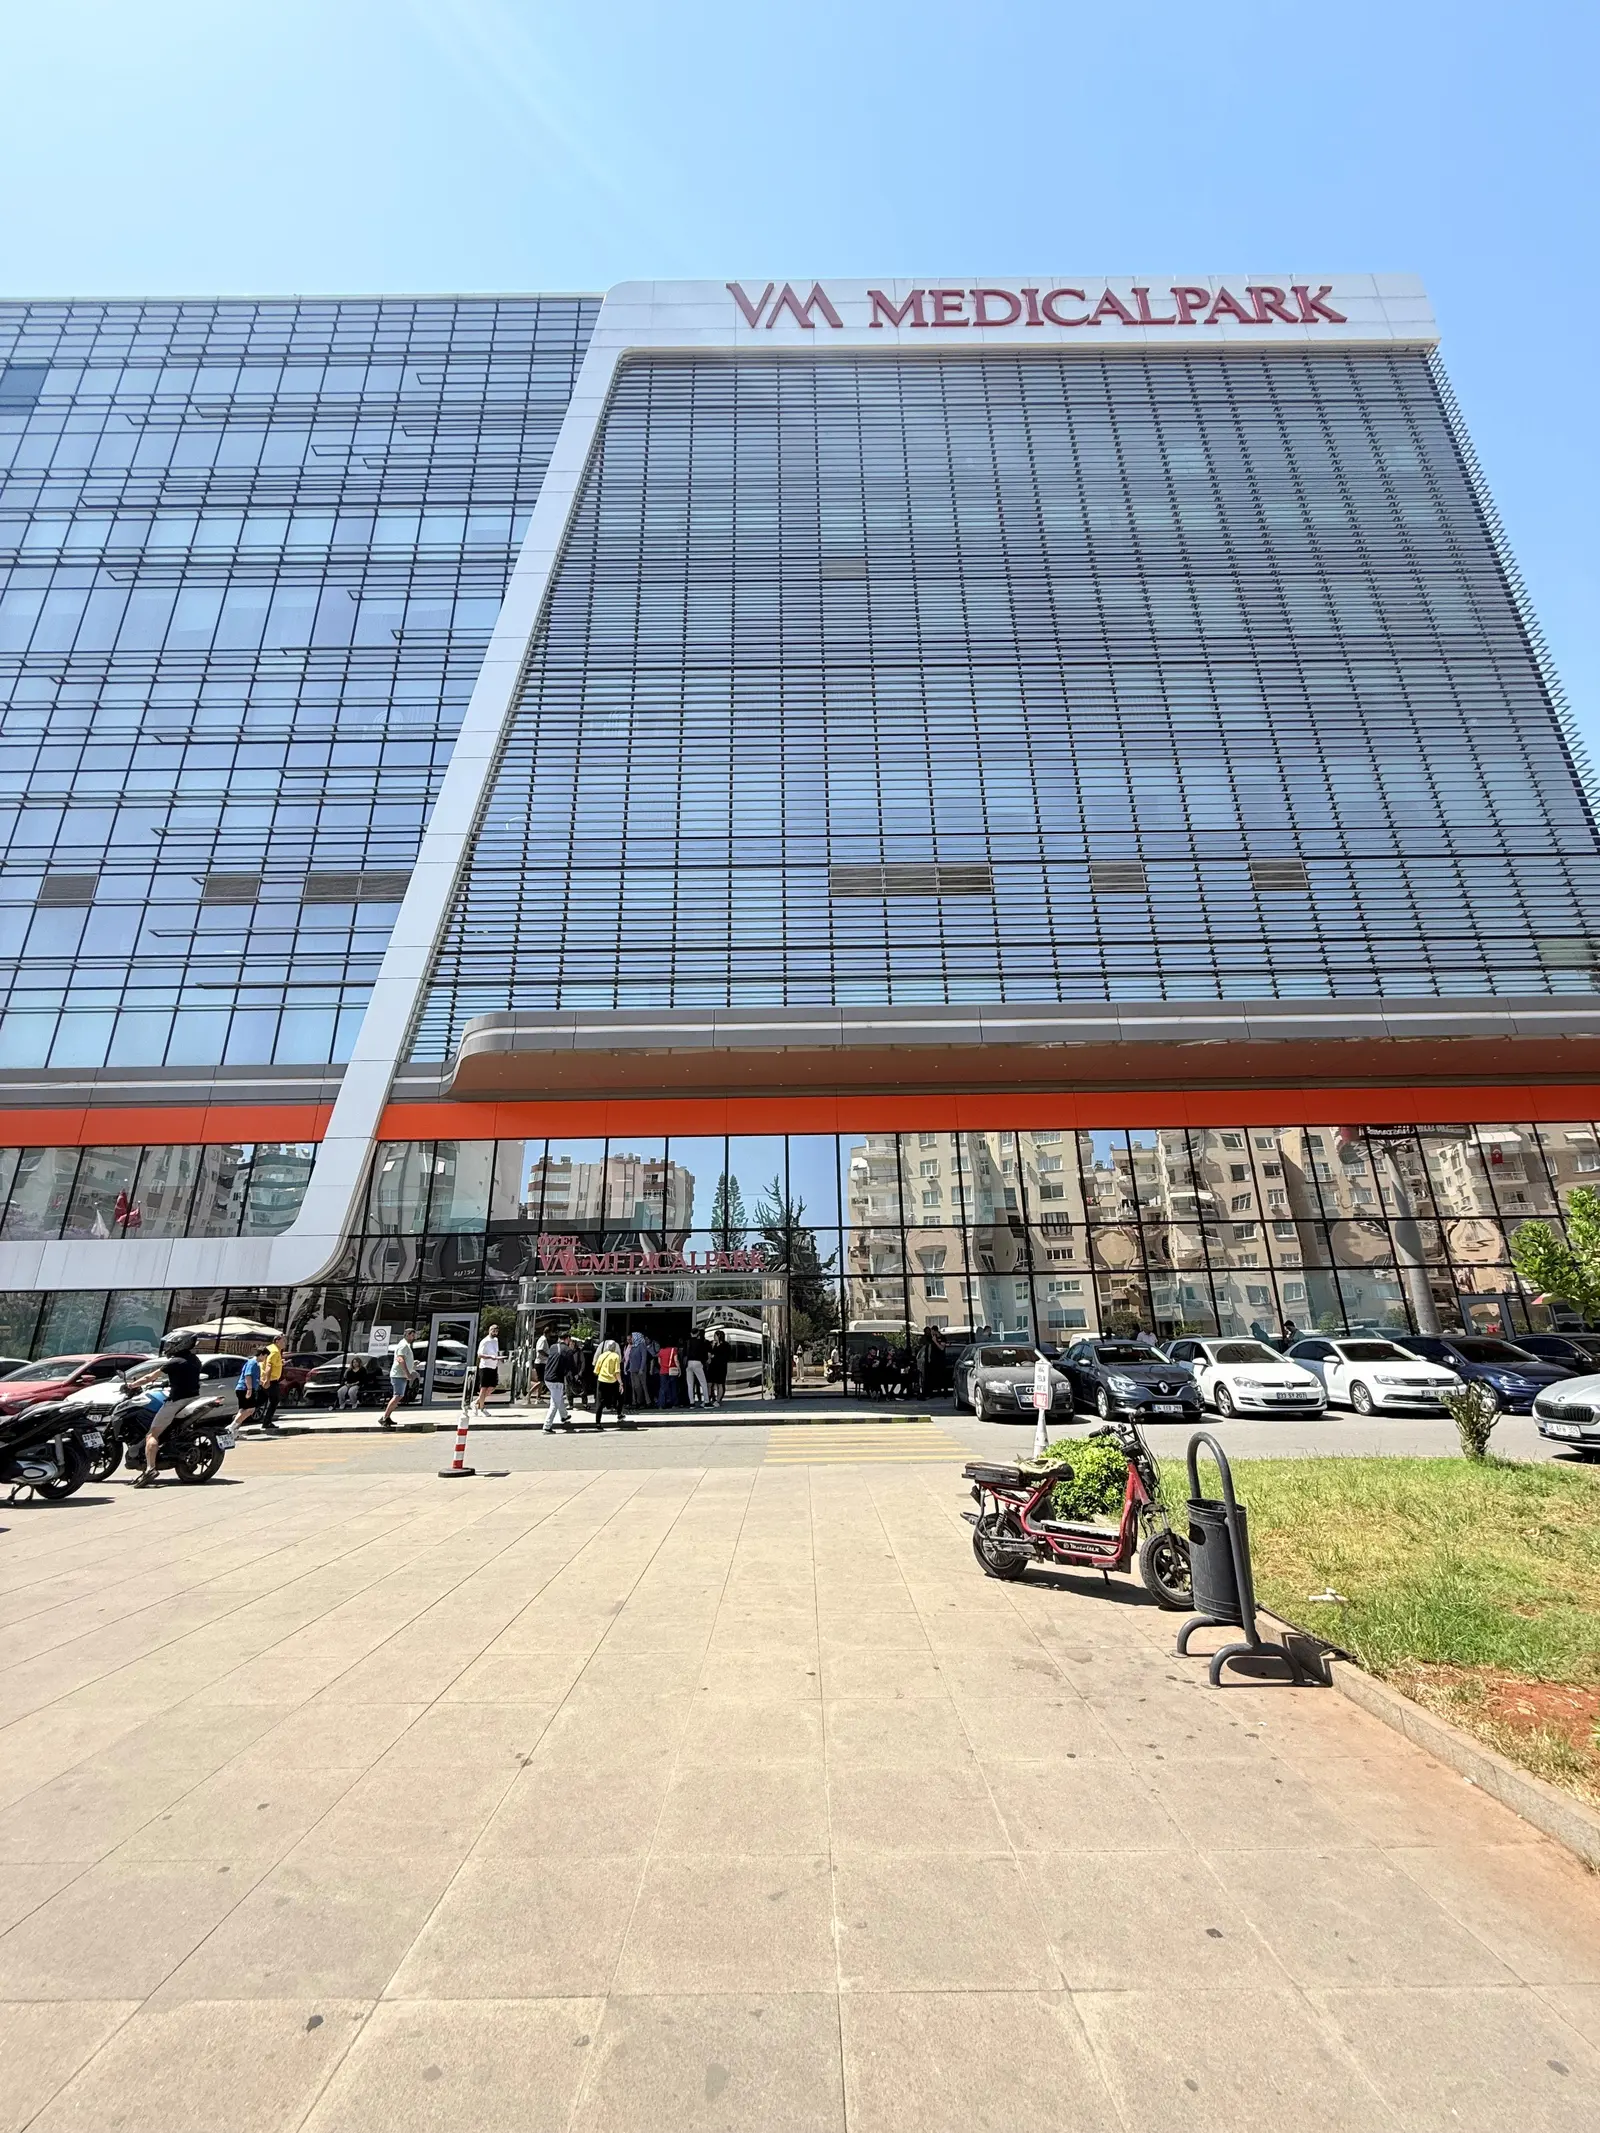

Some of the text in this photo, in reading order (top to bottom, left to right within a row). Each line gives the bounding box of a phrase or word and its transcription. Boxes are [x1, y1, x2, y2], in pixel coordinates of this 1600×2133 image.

[866, 285, 1348, 328] MEDICALPARK
[538, 1233, 580, 1246] ÖZEL
[588, 1249, 767, 1272] MEDICALPARK
